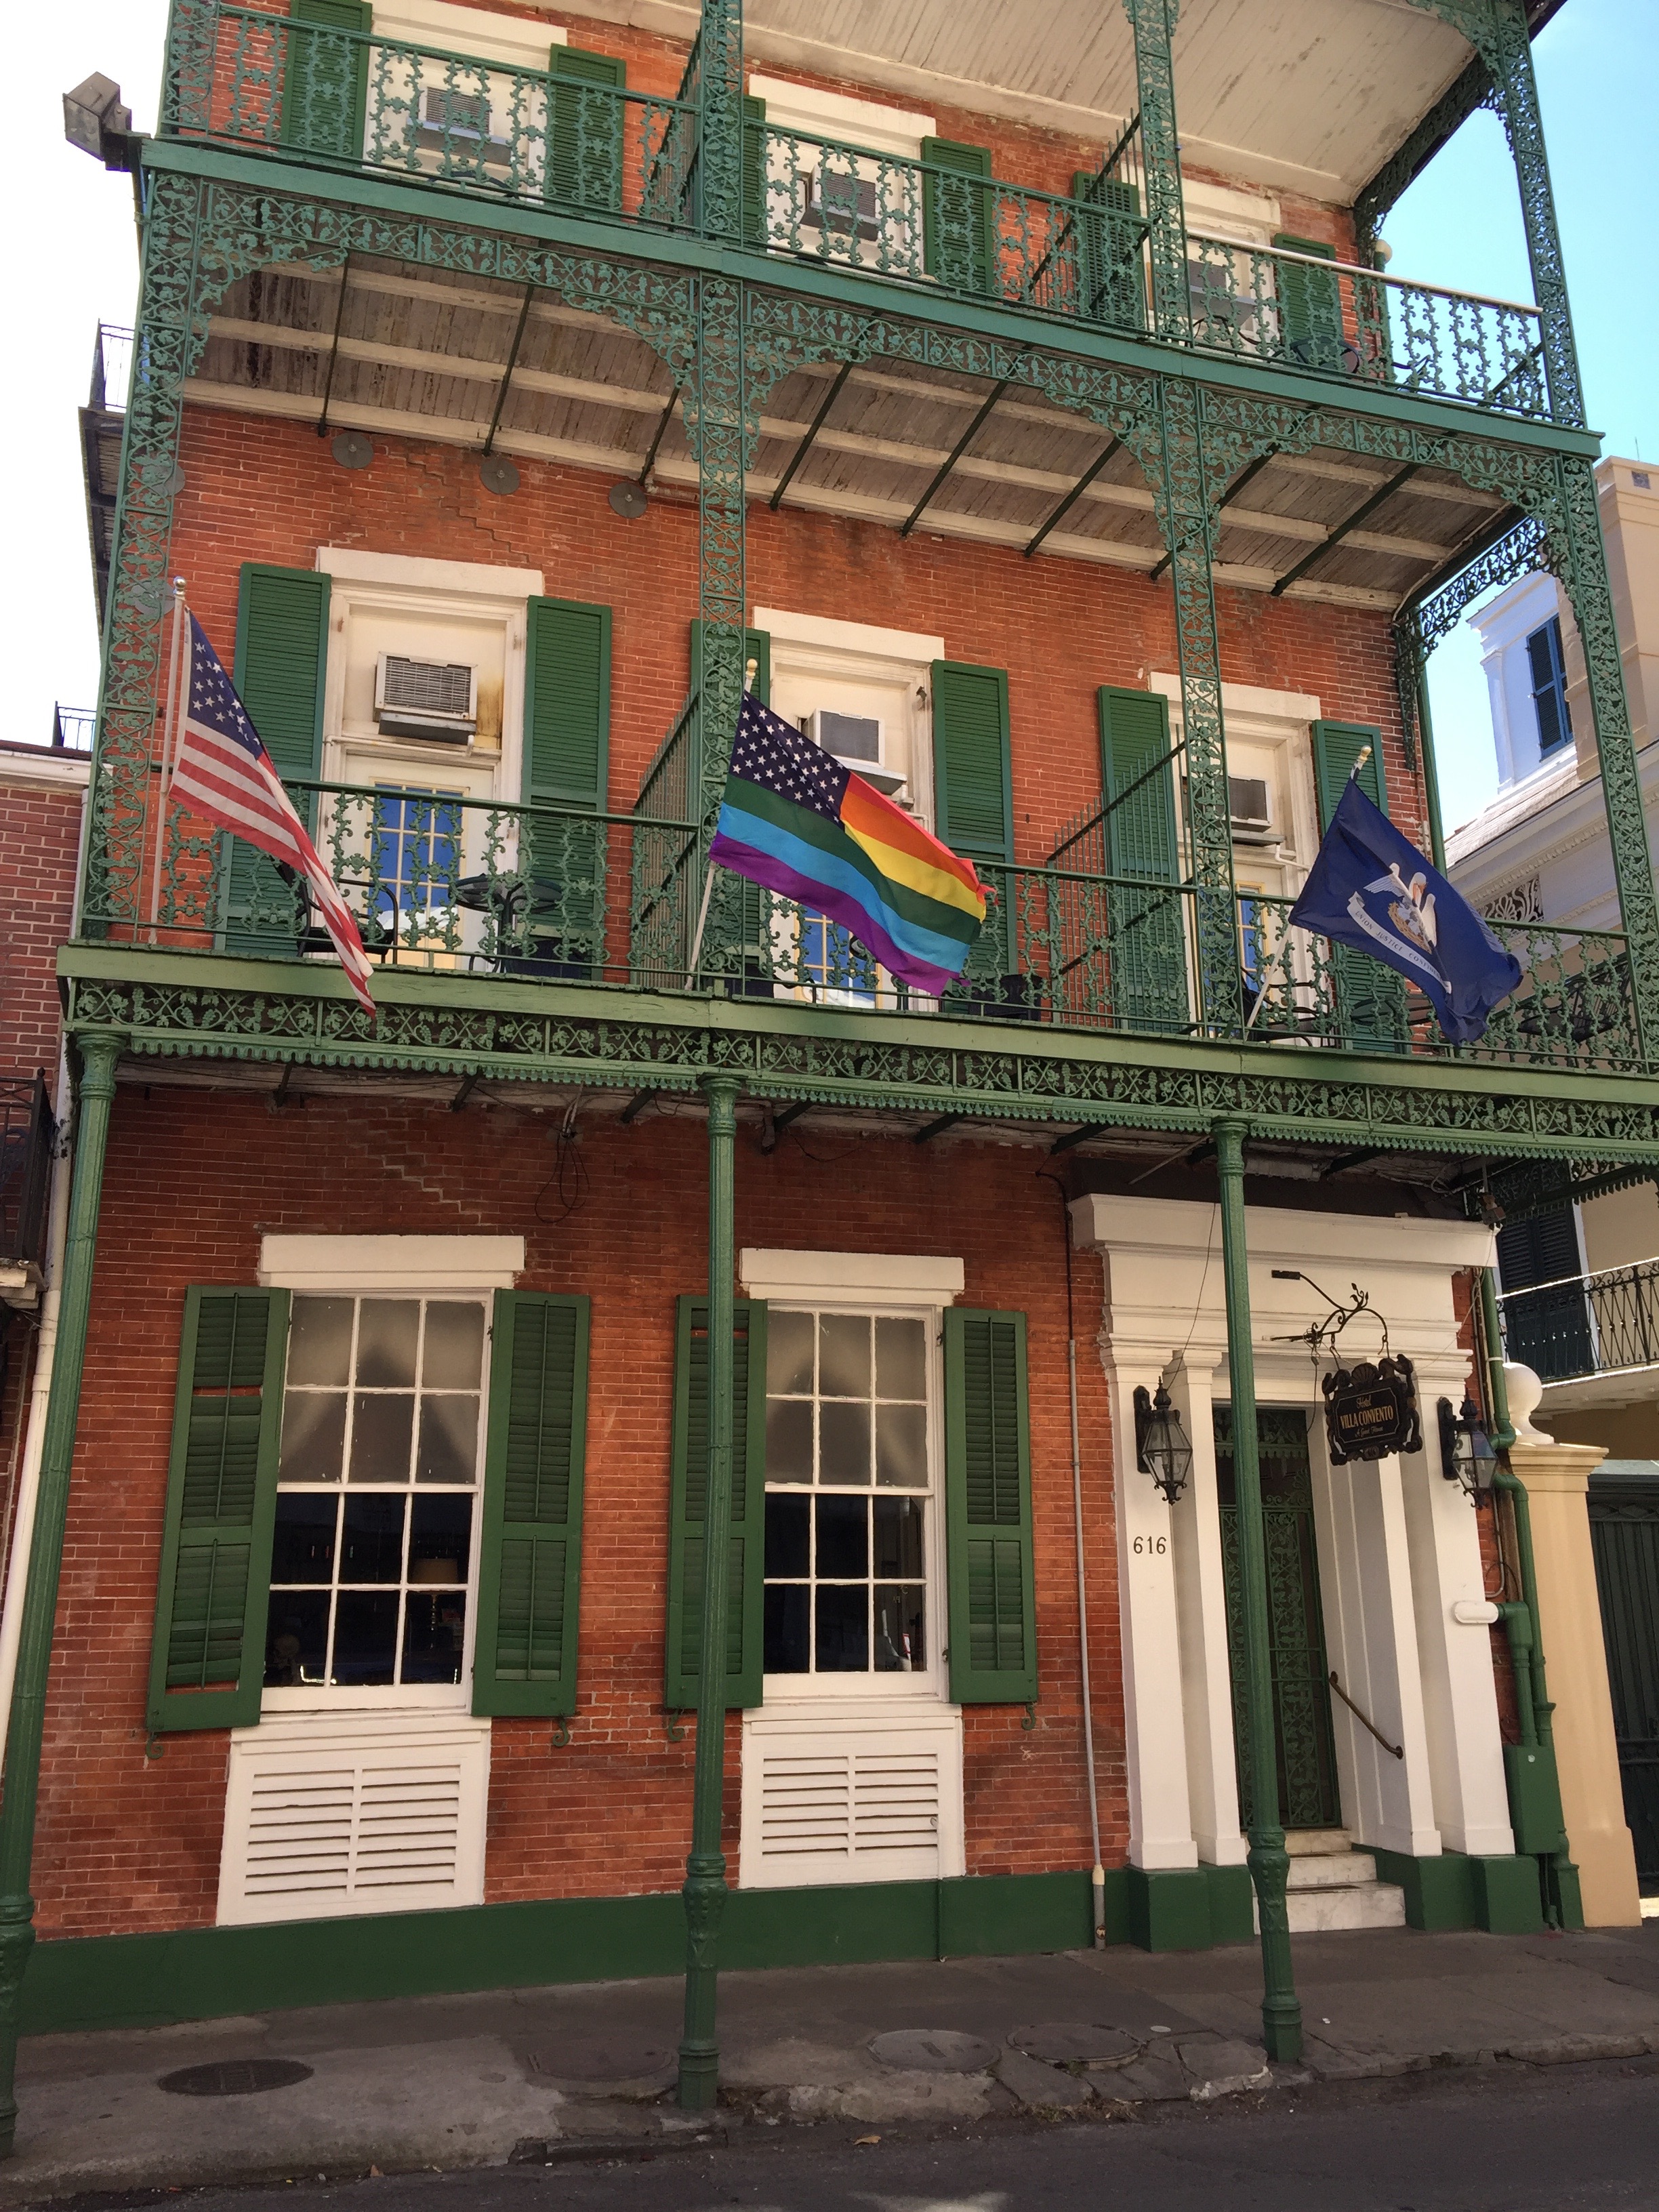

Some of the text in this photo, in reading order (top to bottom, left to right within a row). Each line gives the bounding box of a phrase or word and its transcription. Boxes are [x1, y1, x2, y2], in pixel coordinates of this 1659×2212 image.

[1376, 931, 1403, 951] JUSTICE
[1340, 1405, 1394, 1429] VILLA CONVENTO
[1133, 1536, 1166, 1555] 616
